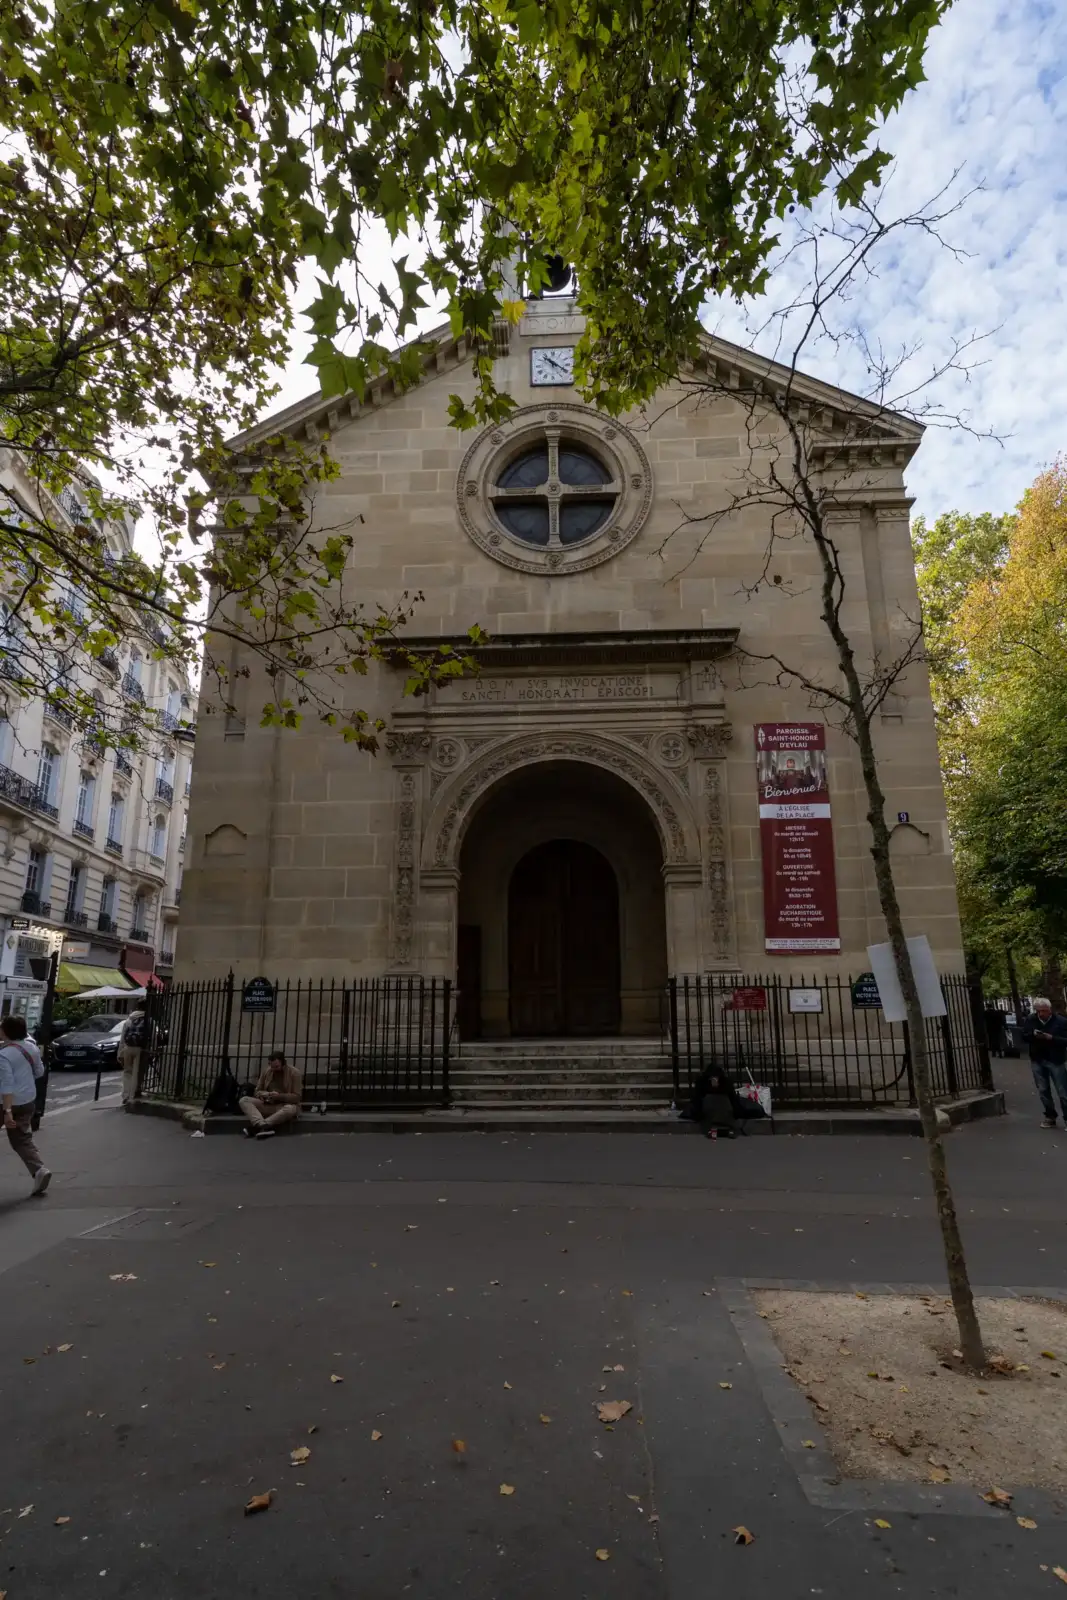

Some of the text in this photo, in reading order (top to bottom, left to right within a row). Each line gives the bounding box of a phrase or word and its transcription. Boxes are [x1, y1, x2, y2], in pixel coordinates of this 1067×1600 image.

[527, 679, 548, 689] SVB
[560, 676, 643, 688] INVOCATIONE
[462, 686, 654, 701] SANCTI HONORATI EPISCOPI
[768, 734, 819, 742] SAINT-HONORÉ
[784, 804, 810, 812] L'ÉGLISE
[900, 812, 907, 822] 9
